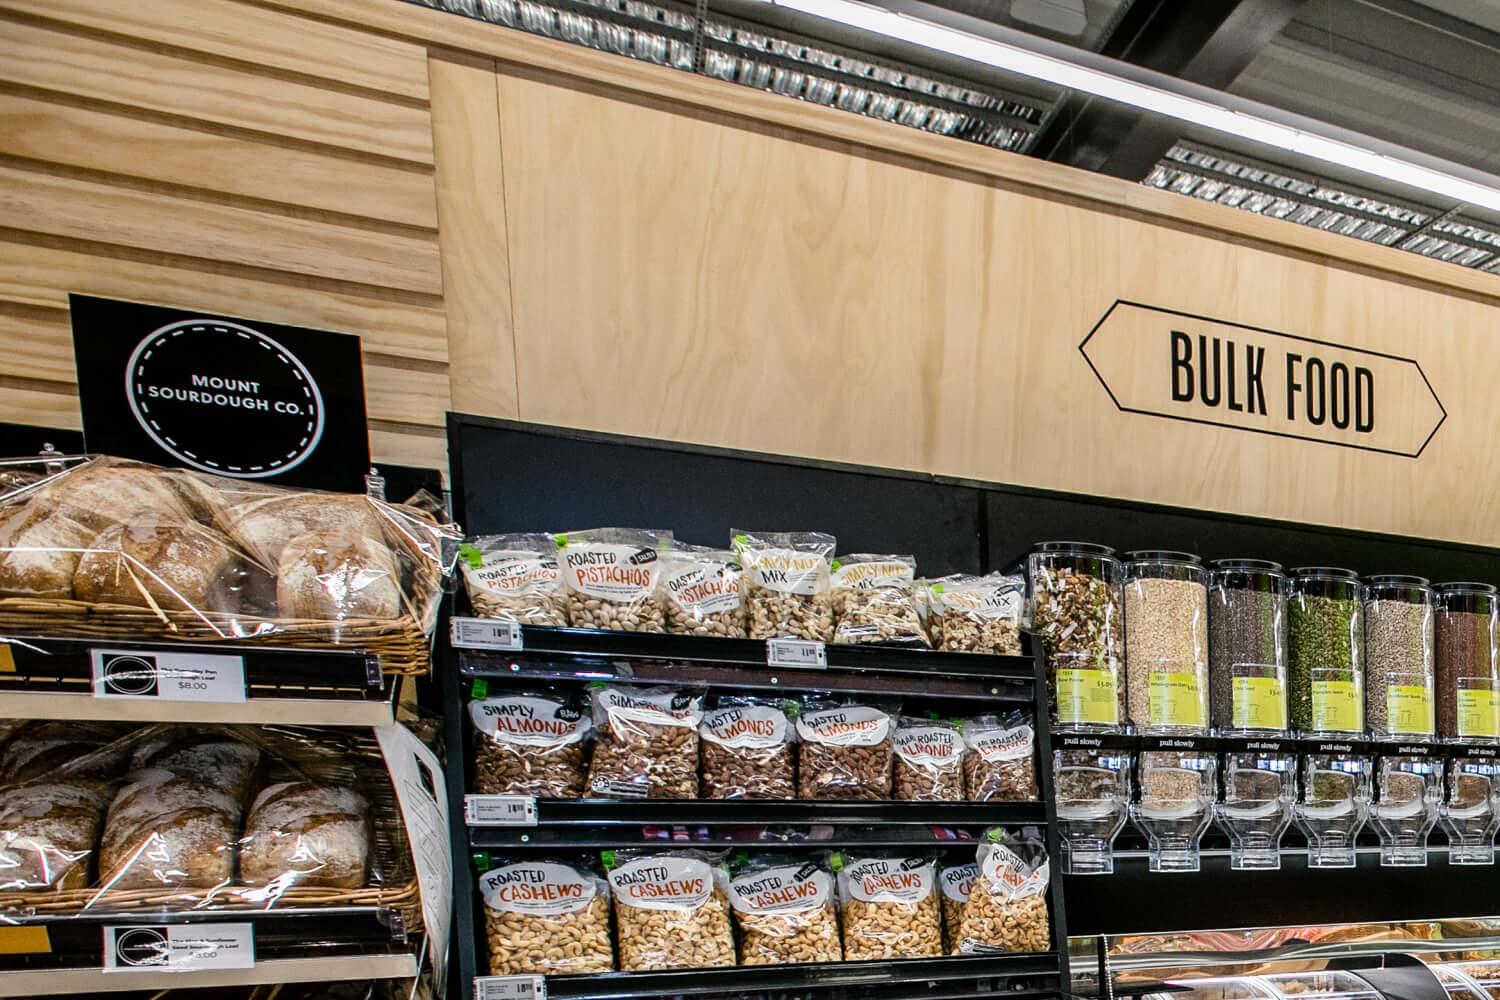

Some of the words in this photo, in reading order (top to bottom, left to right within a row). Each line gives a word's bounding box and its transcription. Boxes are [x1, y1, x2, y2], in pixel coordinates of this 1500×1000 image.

[191, 374, 261, 394] MOUNT
[1170, 330, 1268, 415] BULK
[1286, 352, 1374, 432] FOOD
[148, 385, 269, 411] SOURDOUGH
[275, 401, 304, 415] CO.
[567, 552, 616, 568] ROASTED
[793, 557, 820, 570] NUT
[178, 681, 207, 689] $8.00
[560, 709, 579, 719] RAW
[497, 718, 576, 734] ALMONDS
[1064, 737, 1080, 745] pull
[1081, 738, 1102, 746] slowly
[1160, 739, 1172, 747] pull
[1174, 740, 1194, 749] slowly
[1247, 742, 1260, 750] pull
[1261, 742, 1280, 750] slowly
[488, 870, 546, 890] ROASTED
[614, 867, 668, 887] ROASTED
[852, 861, 888, 883] ROASTED
[500, 884, 582, 902] CASHEWS
[630, 879, 704, 898] CASHEWS
[735, 876, 781, 896] ROASTED
[864, 873, 921, 895] CASHEWS
[748, 882, 817, 909] CASHEWS
